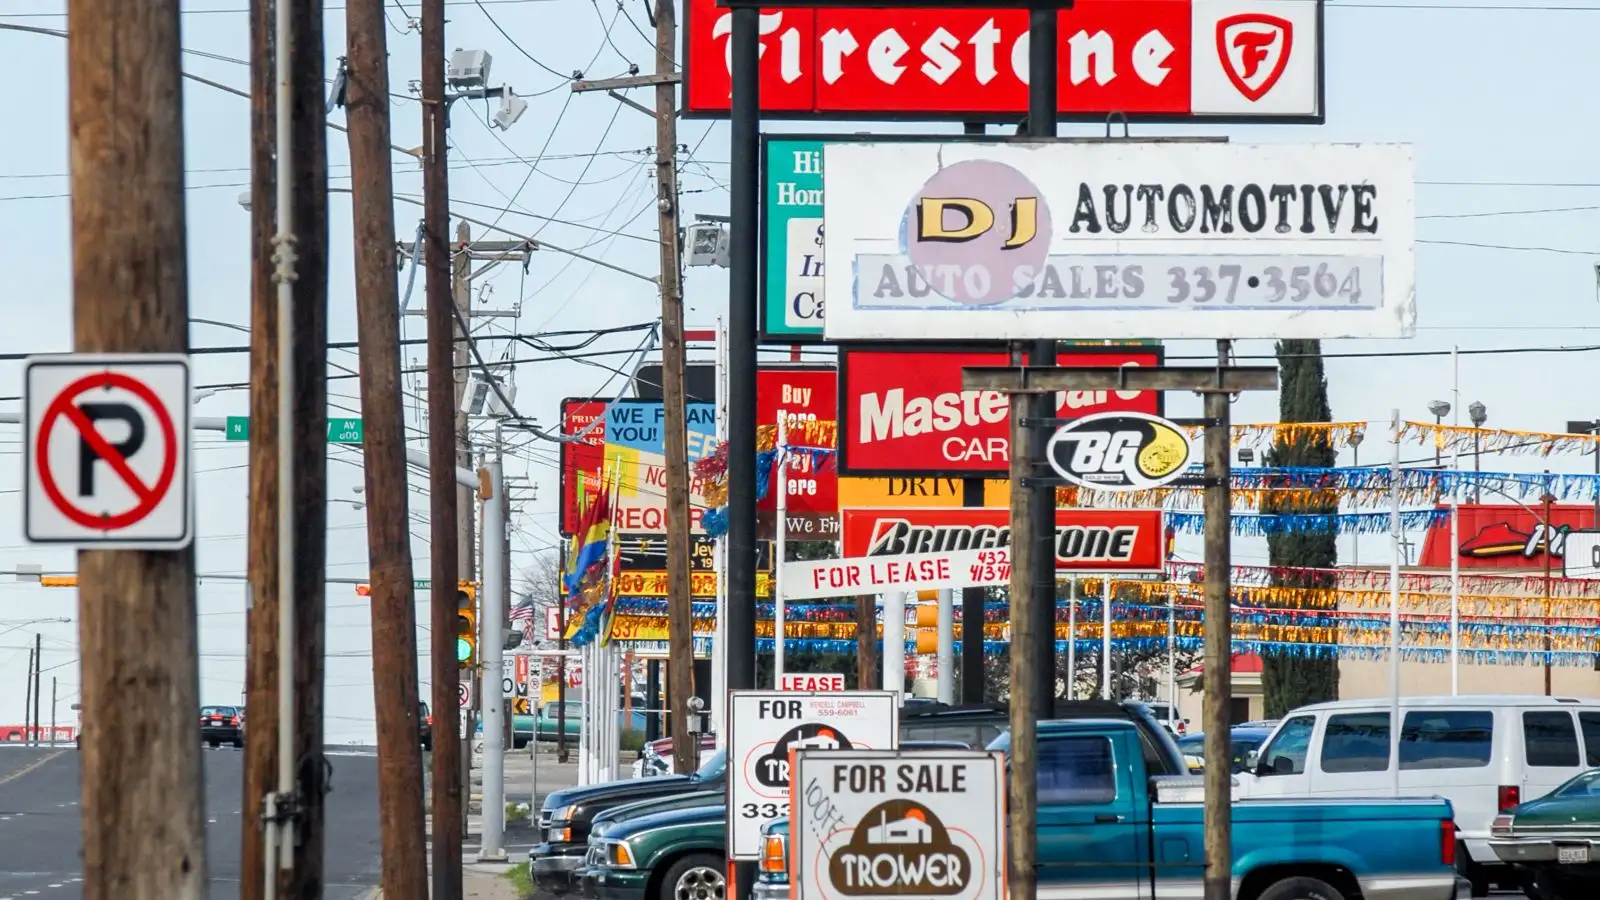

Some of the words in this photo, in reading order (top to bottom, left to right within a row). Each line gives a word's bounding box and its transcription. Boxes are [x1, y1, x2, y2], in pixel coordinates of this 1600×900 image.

[793, 151, 824, 178] Hi
[1069, 182, 1378, 234] AUTOMOTIVE
[873, 263, 991, 300] AUTO
[1012, 264, 1145, 299] SALES
[782, 384, 811, 407] Buy
[343, 422, 355, 430] AV
[612, 408, 643, 424] WE
[612, 427, 657, 442] YOU!
[1056, 430, 1144, 474] BG
[787, 479, 817, 496] ere
[787, 518, 813, 533] We
[813, 566, 860, 589] FOR
[871, 558, 950, 585] LEASE
[782, 676, 843, 691] LEASE
[759, 700, 802, 720] FOR
[833, 765, 886, 793] FOR
[897, 764, 966, 793] SALE
[840, 852, 964, 888] TROWER
